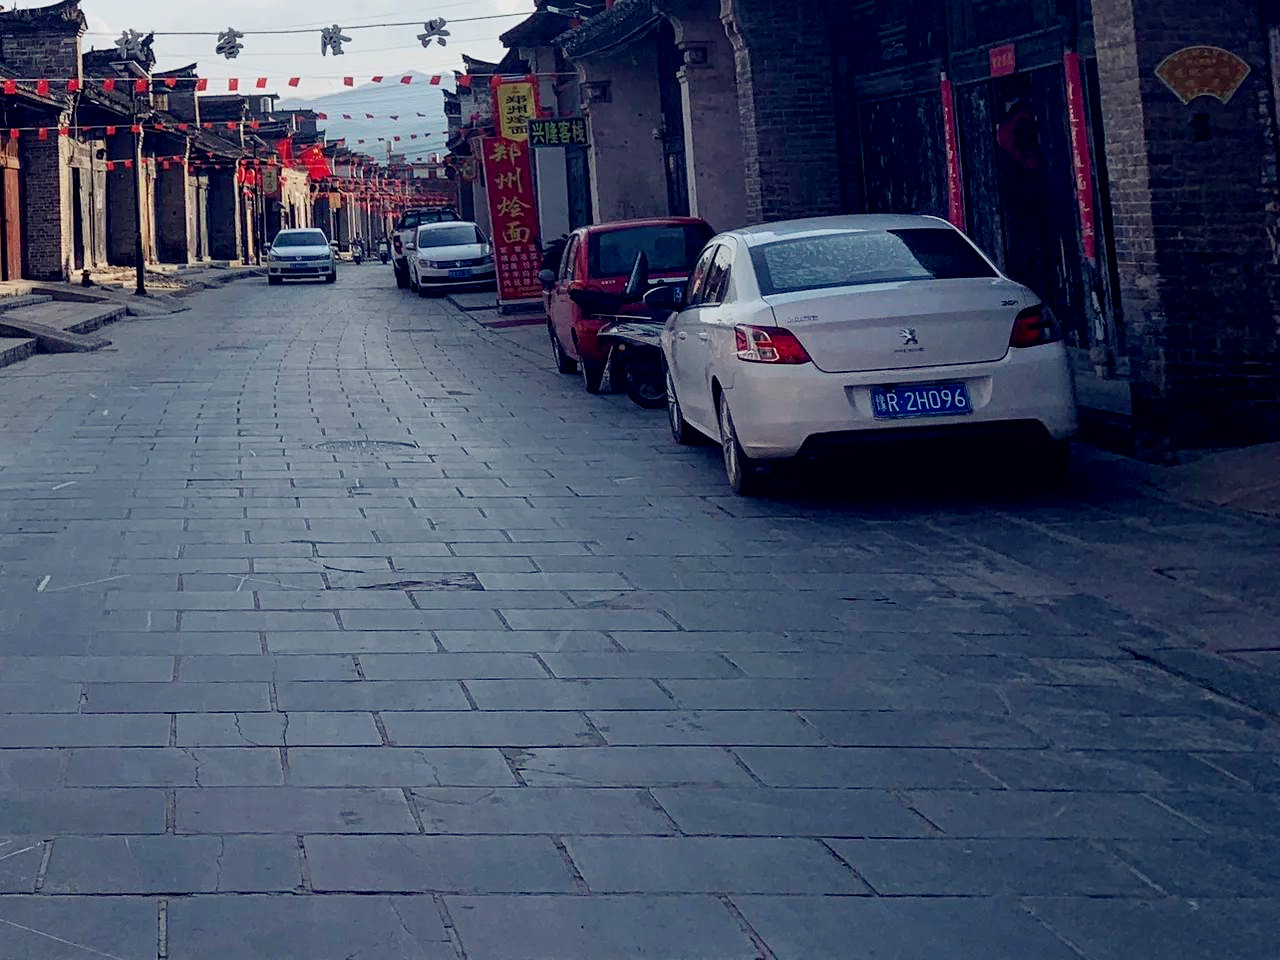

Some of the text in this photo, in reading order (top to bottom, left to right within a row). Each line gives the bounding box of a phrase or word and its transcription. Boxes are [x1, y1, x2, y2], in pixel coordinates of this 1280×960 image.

[531, 119, 586, 145] 兴隆客栈
[488, 142, 533, 244] 郑州烩面
